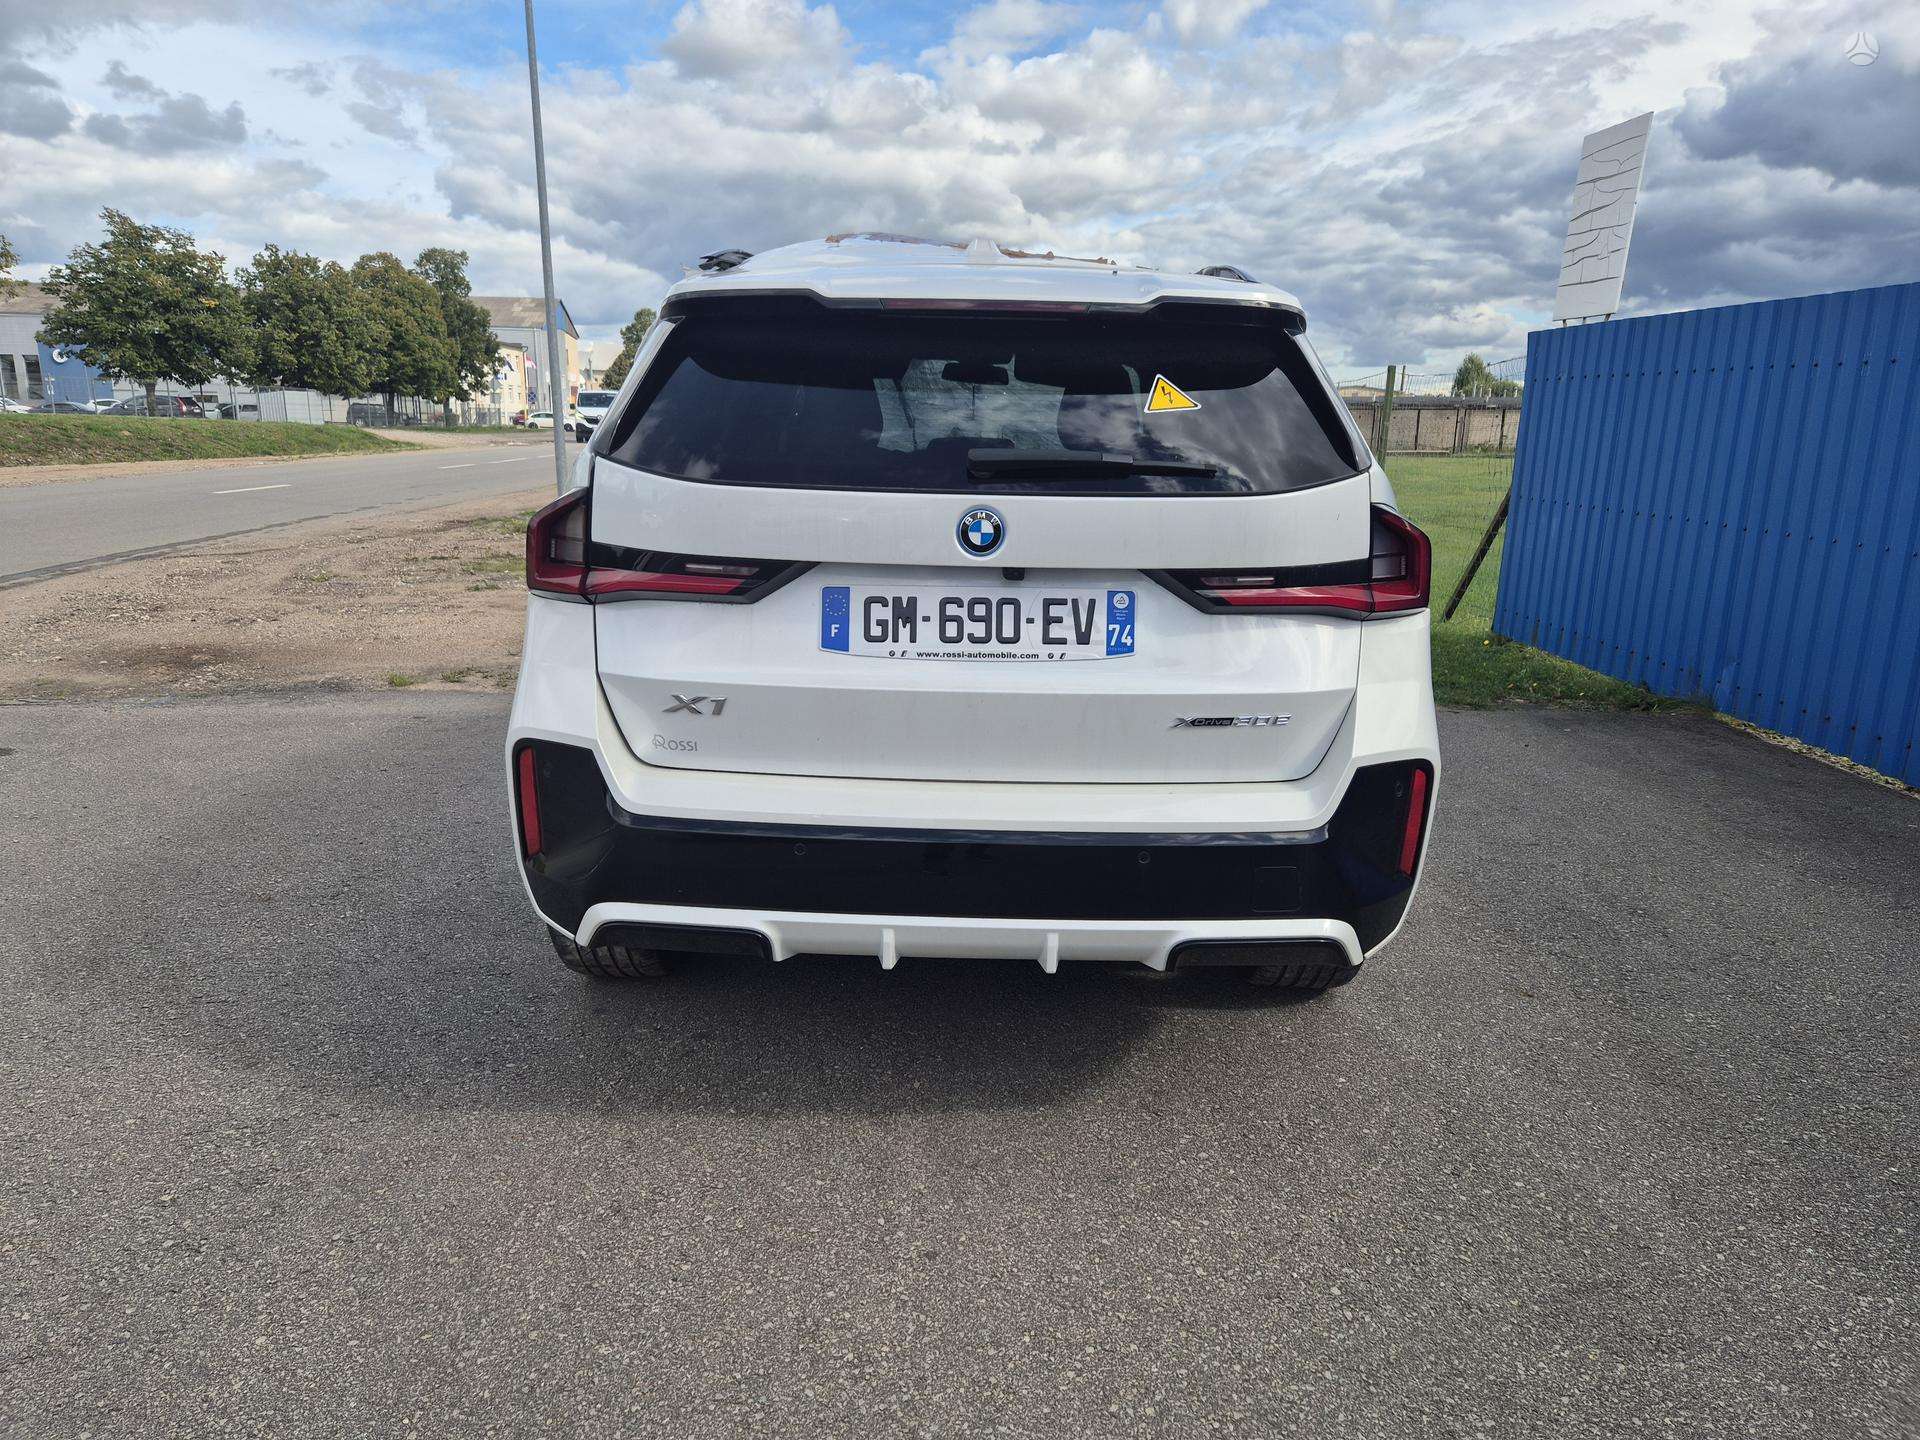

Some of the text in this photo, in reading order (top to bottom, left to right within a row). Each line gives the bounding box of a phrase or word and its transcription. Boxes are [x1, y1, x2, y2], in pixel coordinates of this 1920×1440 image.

[965, 512, 1000, 526] BMW
[863, 596, 1097, 646] GM-690-EV
[831, 624, 840, 637] F
[1108, 624, 1133, 647] 74
[916, 650, 1040, 660] www.rossi-automobile.com
[662, 694, 728, 716] X1
